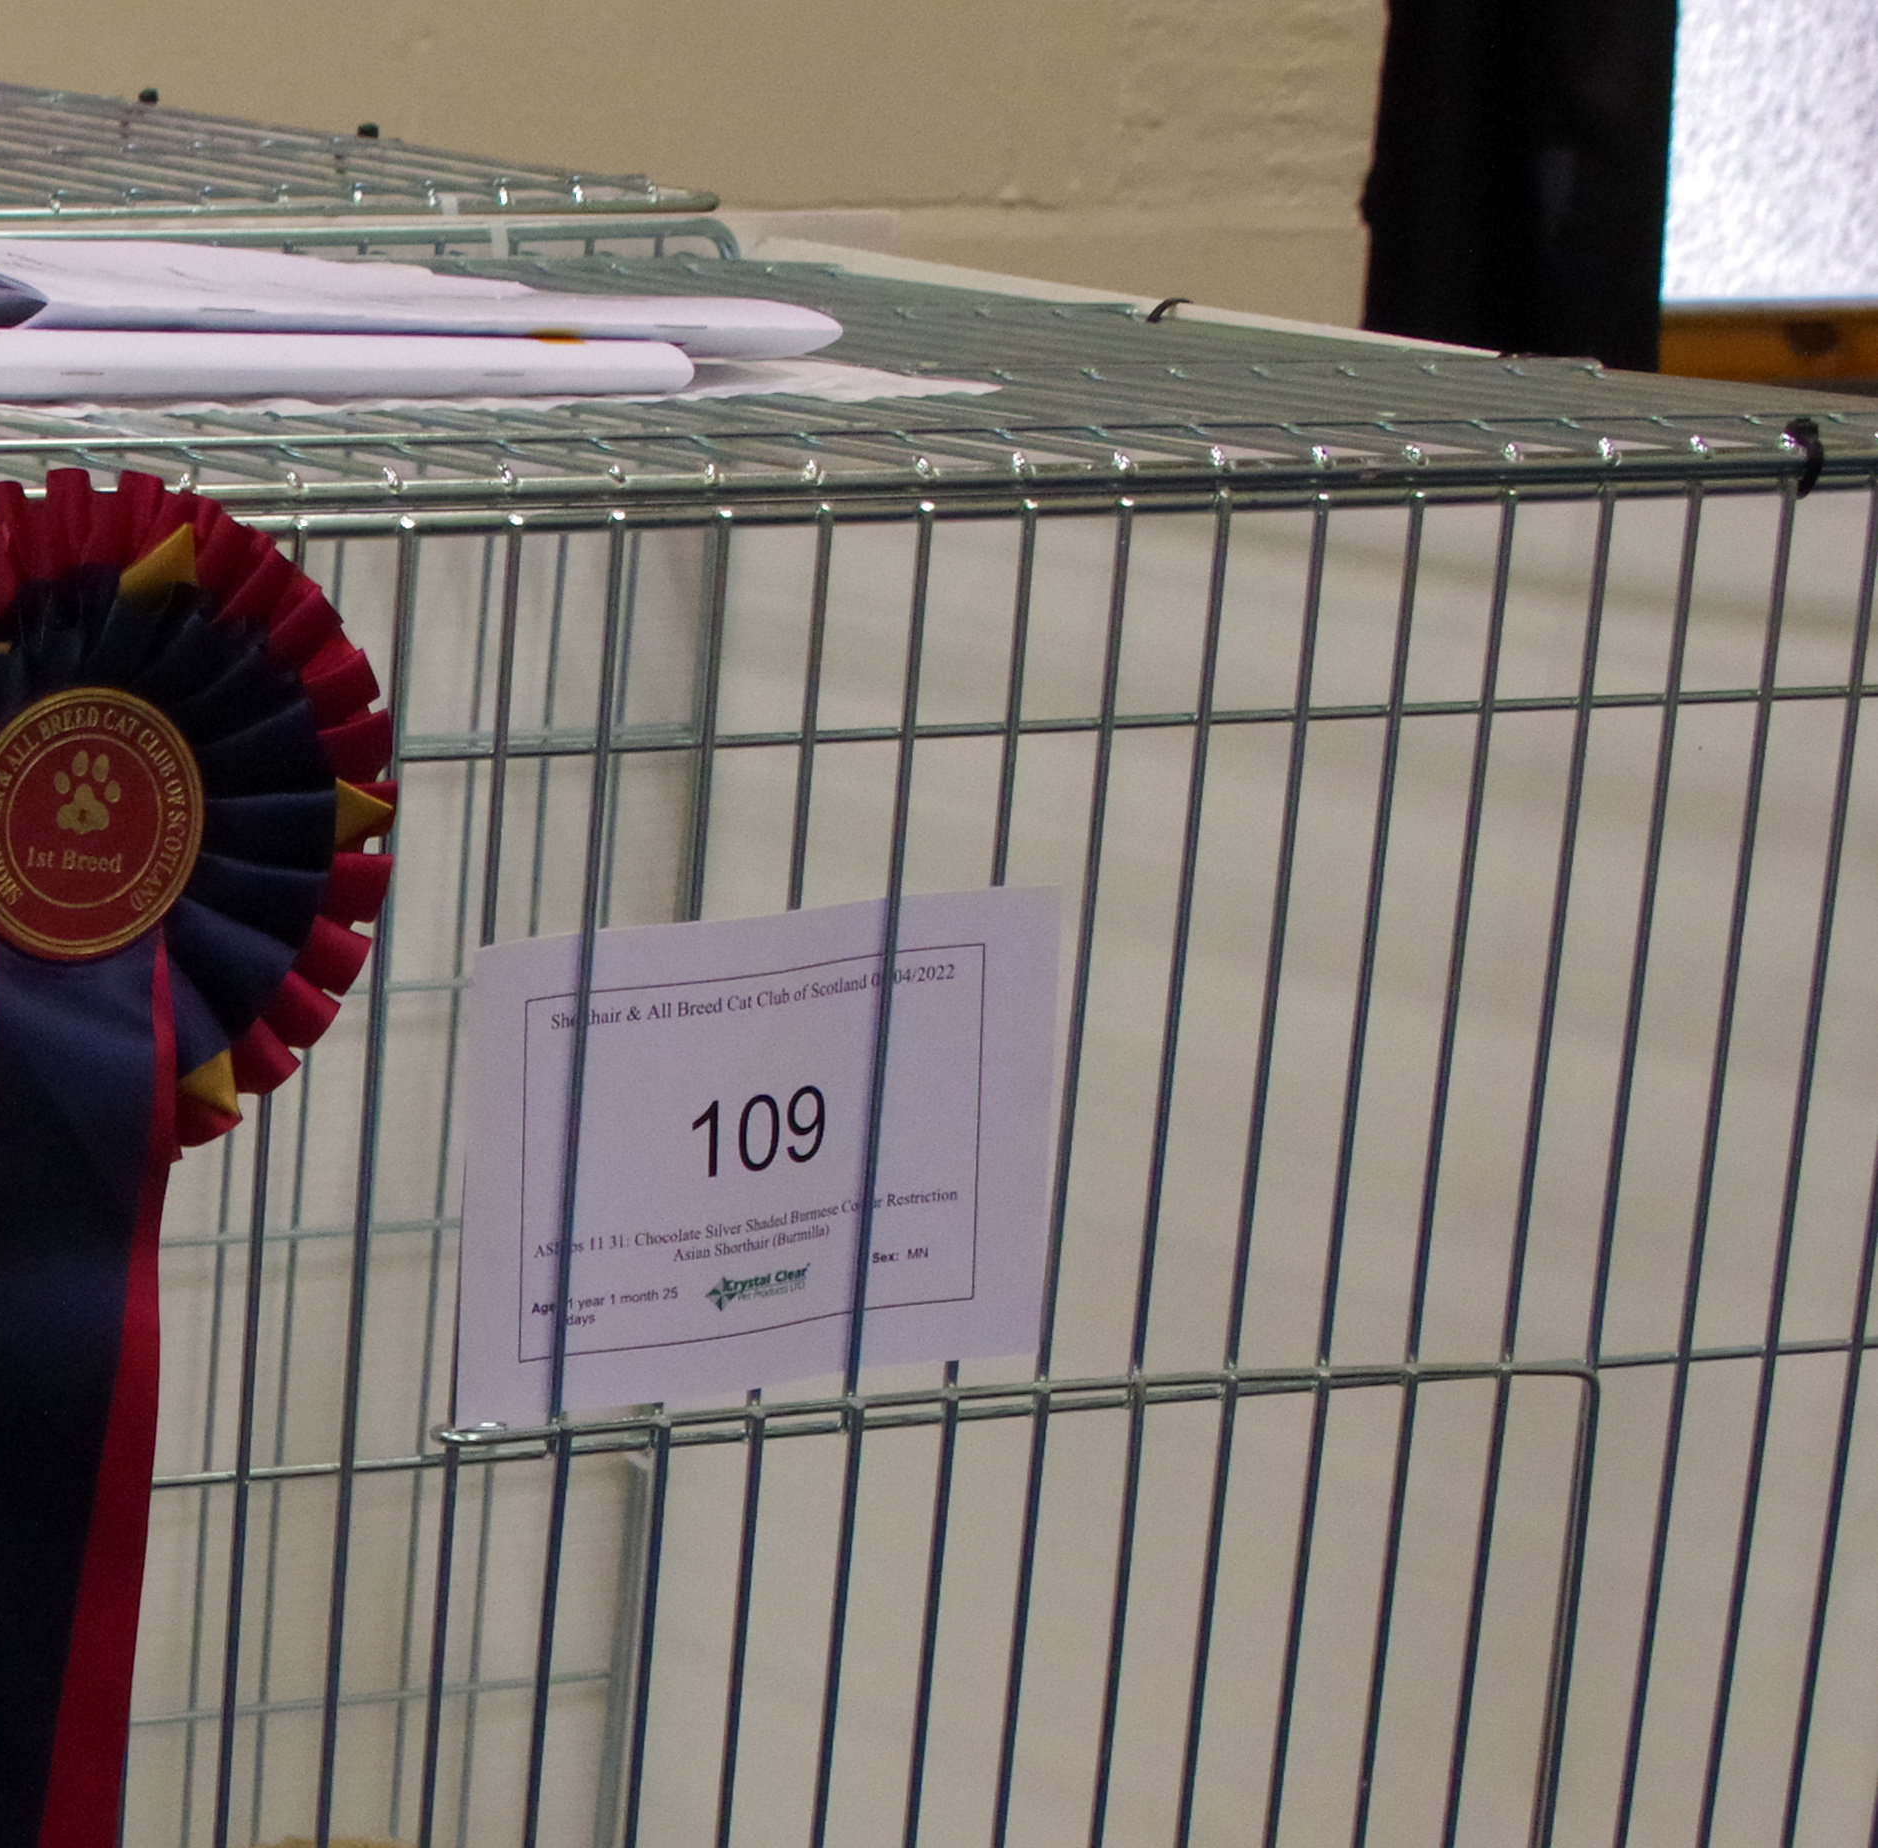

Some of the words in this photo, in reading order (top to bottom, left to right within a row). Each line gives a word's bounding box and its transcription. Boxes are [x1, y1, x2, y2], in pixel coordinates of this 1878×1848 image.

[37, 706, 100, 740] BREED
[103, 708, 141, 738] CAT
[5, 735, 40, 772] ALL
[137, 728, 178, 778] CLUB
[164, 778, 186, 807] OF
[26, 846, 55, 868] 1st
[60, 849, 122, 873] Breed
[130, 809, 186, 912] SCOTLAND
[551, 1009, 622, 1030] Shohair
[626, 1006, 641, 1021] &
[646, 1002, 672, 1020] All
[677, 998, 722, 1018] Breed
[727, 995, 752, 1011] Cat
[757, 988, 790, 1008] Club
[794, 984, 811, 1002] of
[811, 973, 867, 999] Scotland
[871, 964, 955, 988] 004/2022
[691, 1084, 827, 1178] 109
[589, 1236, 604, 1251] 11
[634, 1229, 702, 1247] Chocolate
[705, 1222, 743, 1239] Silver
[745, 1212, 788, 1233] Shaded
[790, 1204, 840, 1225] Burmese
[886, 1189, 958, 1208] Restriction
[673, 1247, 711, 1262] Asian
[714, 1235, 769, 1257] Shorthair
[772, 1224, 830, 1249] (Burmilla)
[872, 1251, 900, 1264] Sex:
[907, 1247, 929, 1260] MN
[724, 1273, 771, 1295] Crystal
[775, 1266, 808, 1282] Clear
[531, 1302, 561, 1316] Age
[567, 1297, 573, 1309] 1
[577, 1296, 605, 1311] year
[610, 1293, 615, 1305] 1
[619, 1290, 659, 1304] month
[662, 1286, 679, 1300] 25
[566, 1312, 596, 1328] days
